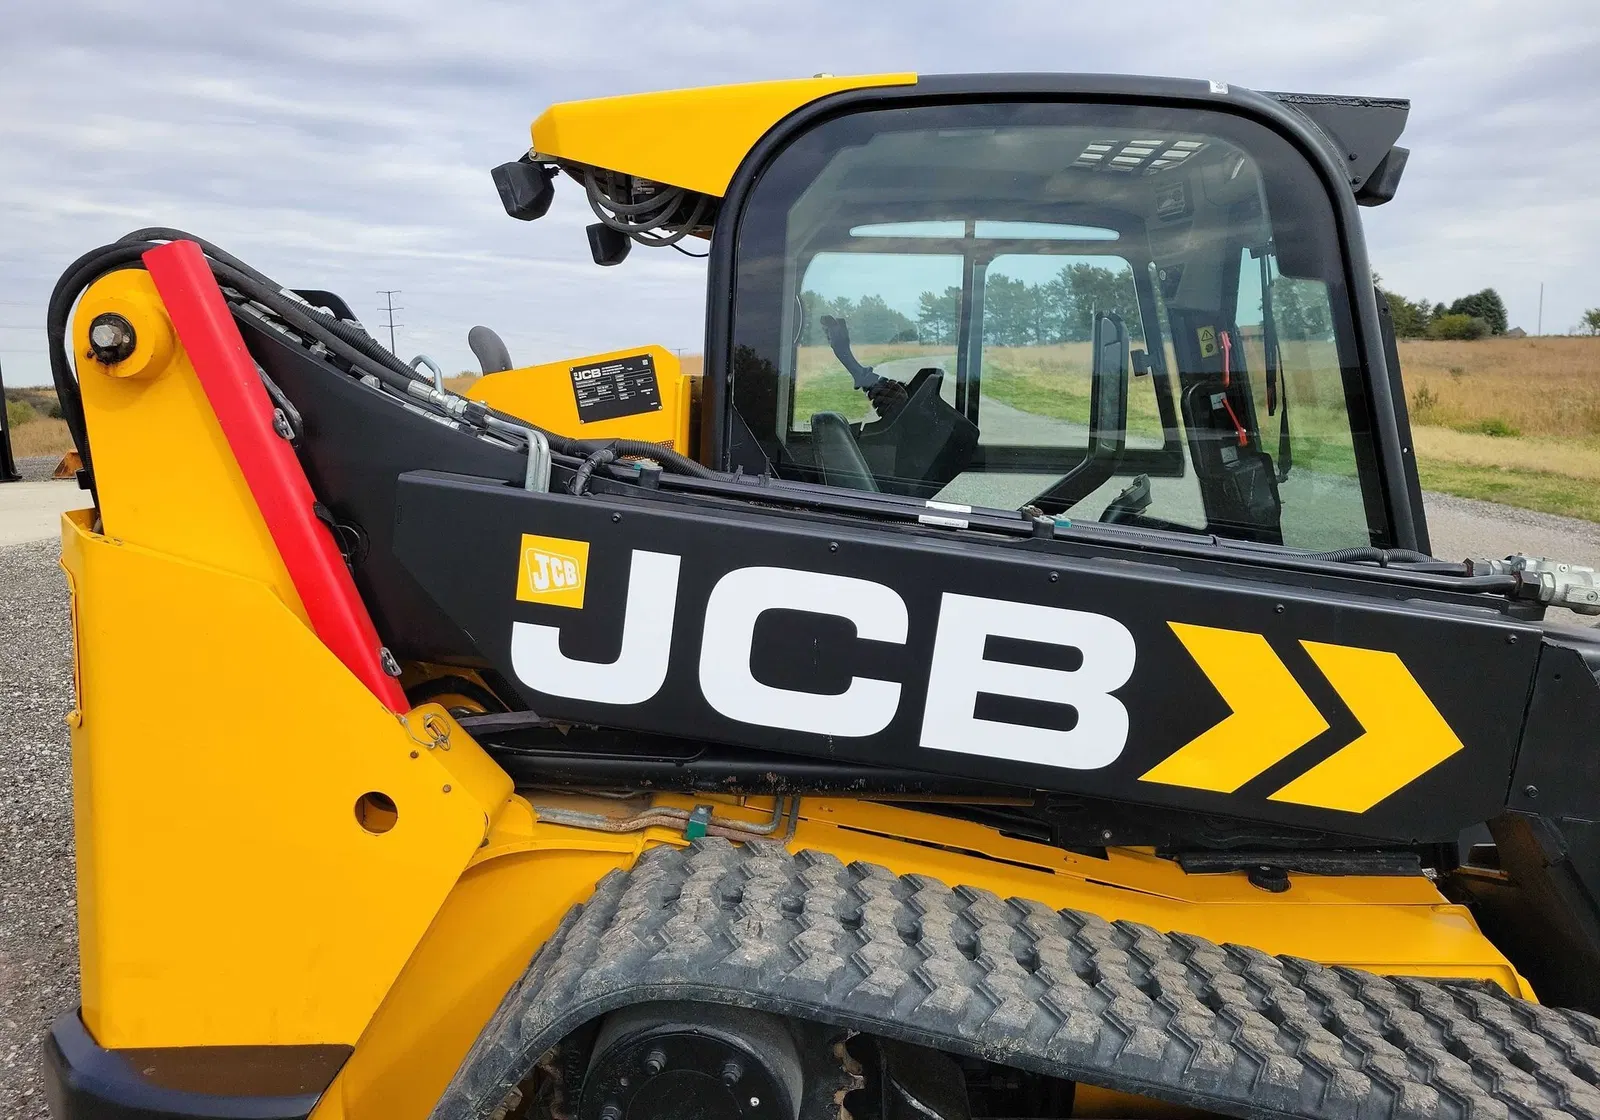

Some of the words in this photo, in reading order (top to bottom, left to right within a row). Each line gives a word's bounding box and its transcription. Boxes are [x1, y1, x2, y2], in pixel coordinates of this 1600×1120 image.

[574, 368, 601, 381] JCB
[533, 552, 577, 590] JCB
[511, 549, 1136, 769] JCB
